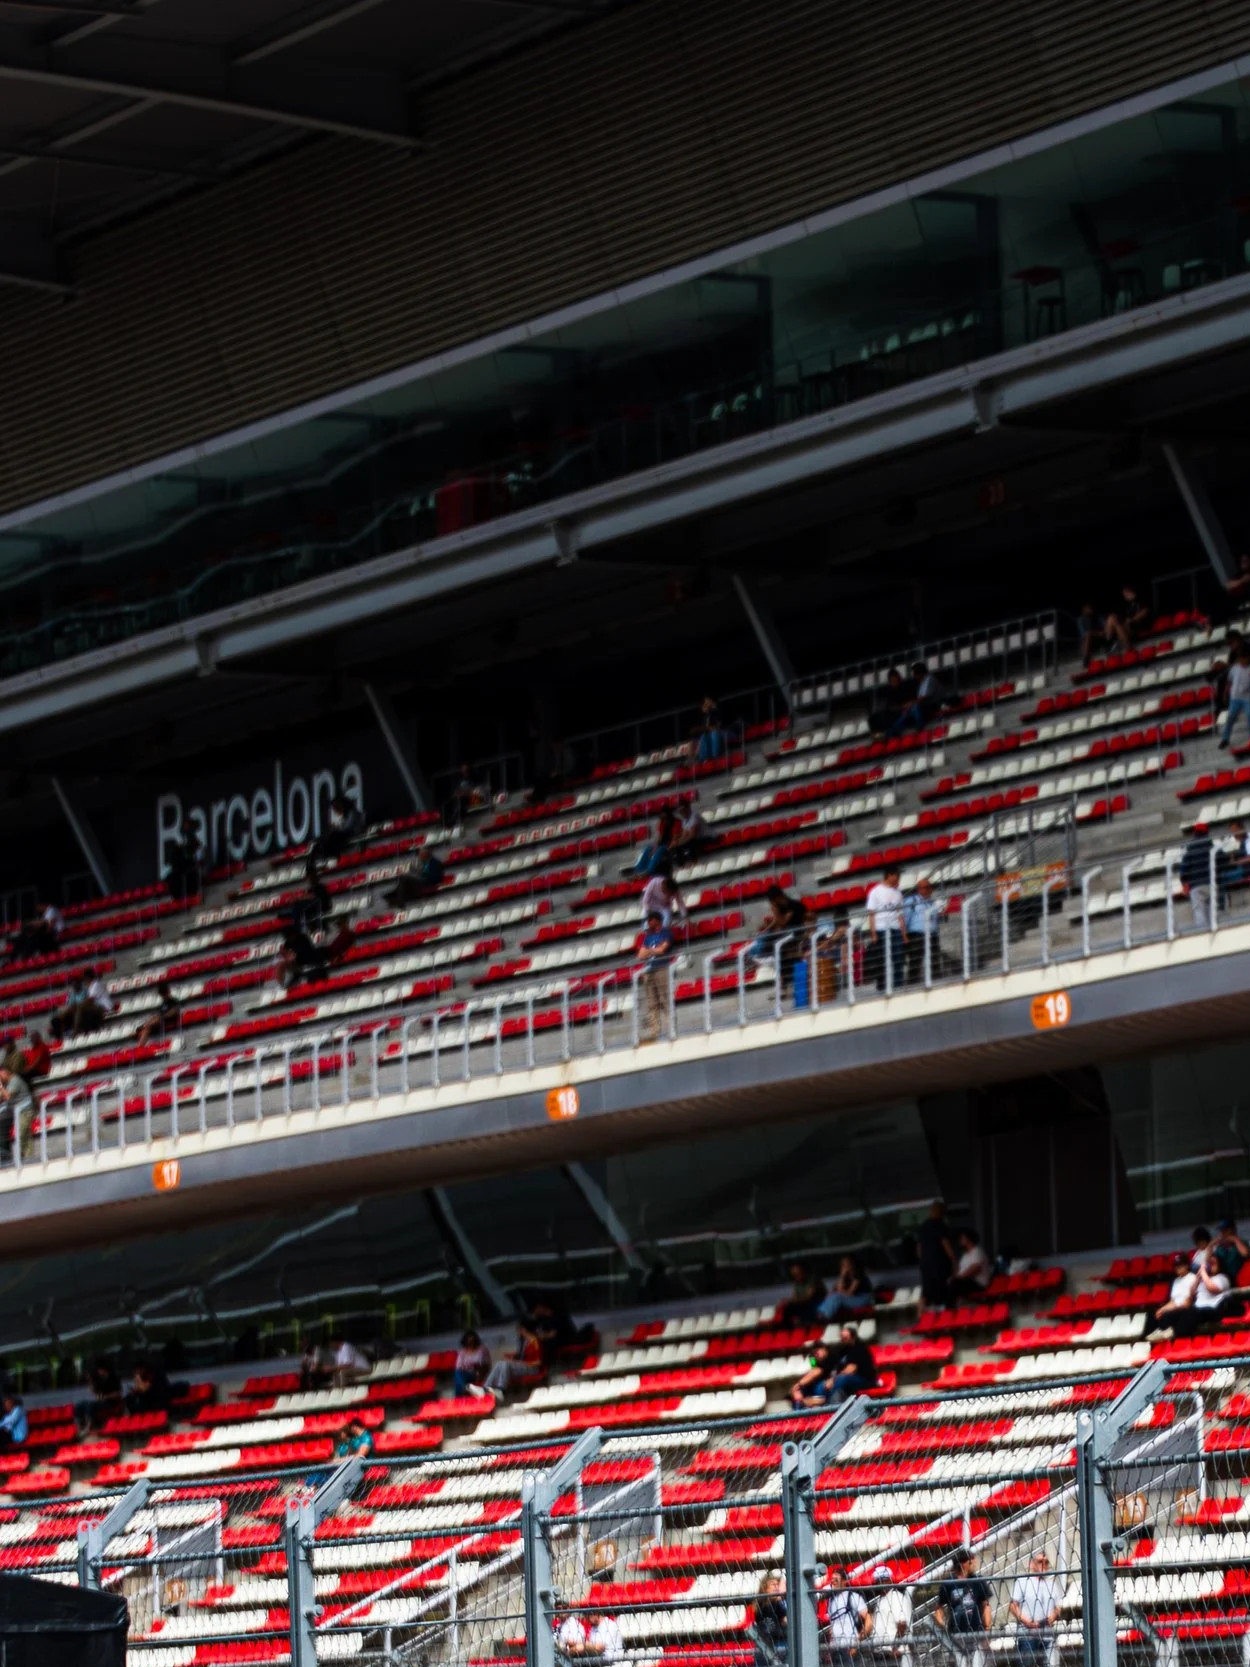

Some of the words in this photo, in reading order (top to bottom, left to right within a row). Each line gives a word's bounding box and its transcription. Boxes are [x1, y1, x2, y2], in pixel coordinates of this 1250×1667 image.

[157, 759, 364, 880] Barcelona
[1045, 993, 1068, 1024] 19
[559, 1088, 577, 1116] 18
[162, 1160, 178, 1187] 17
